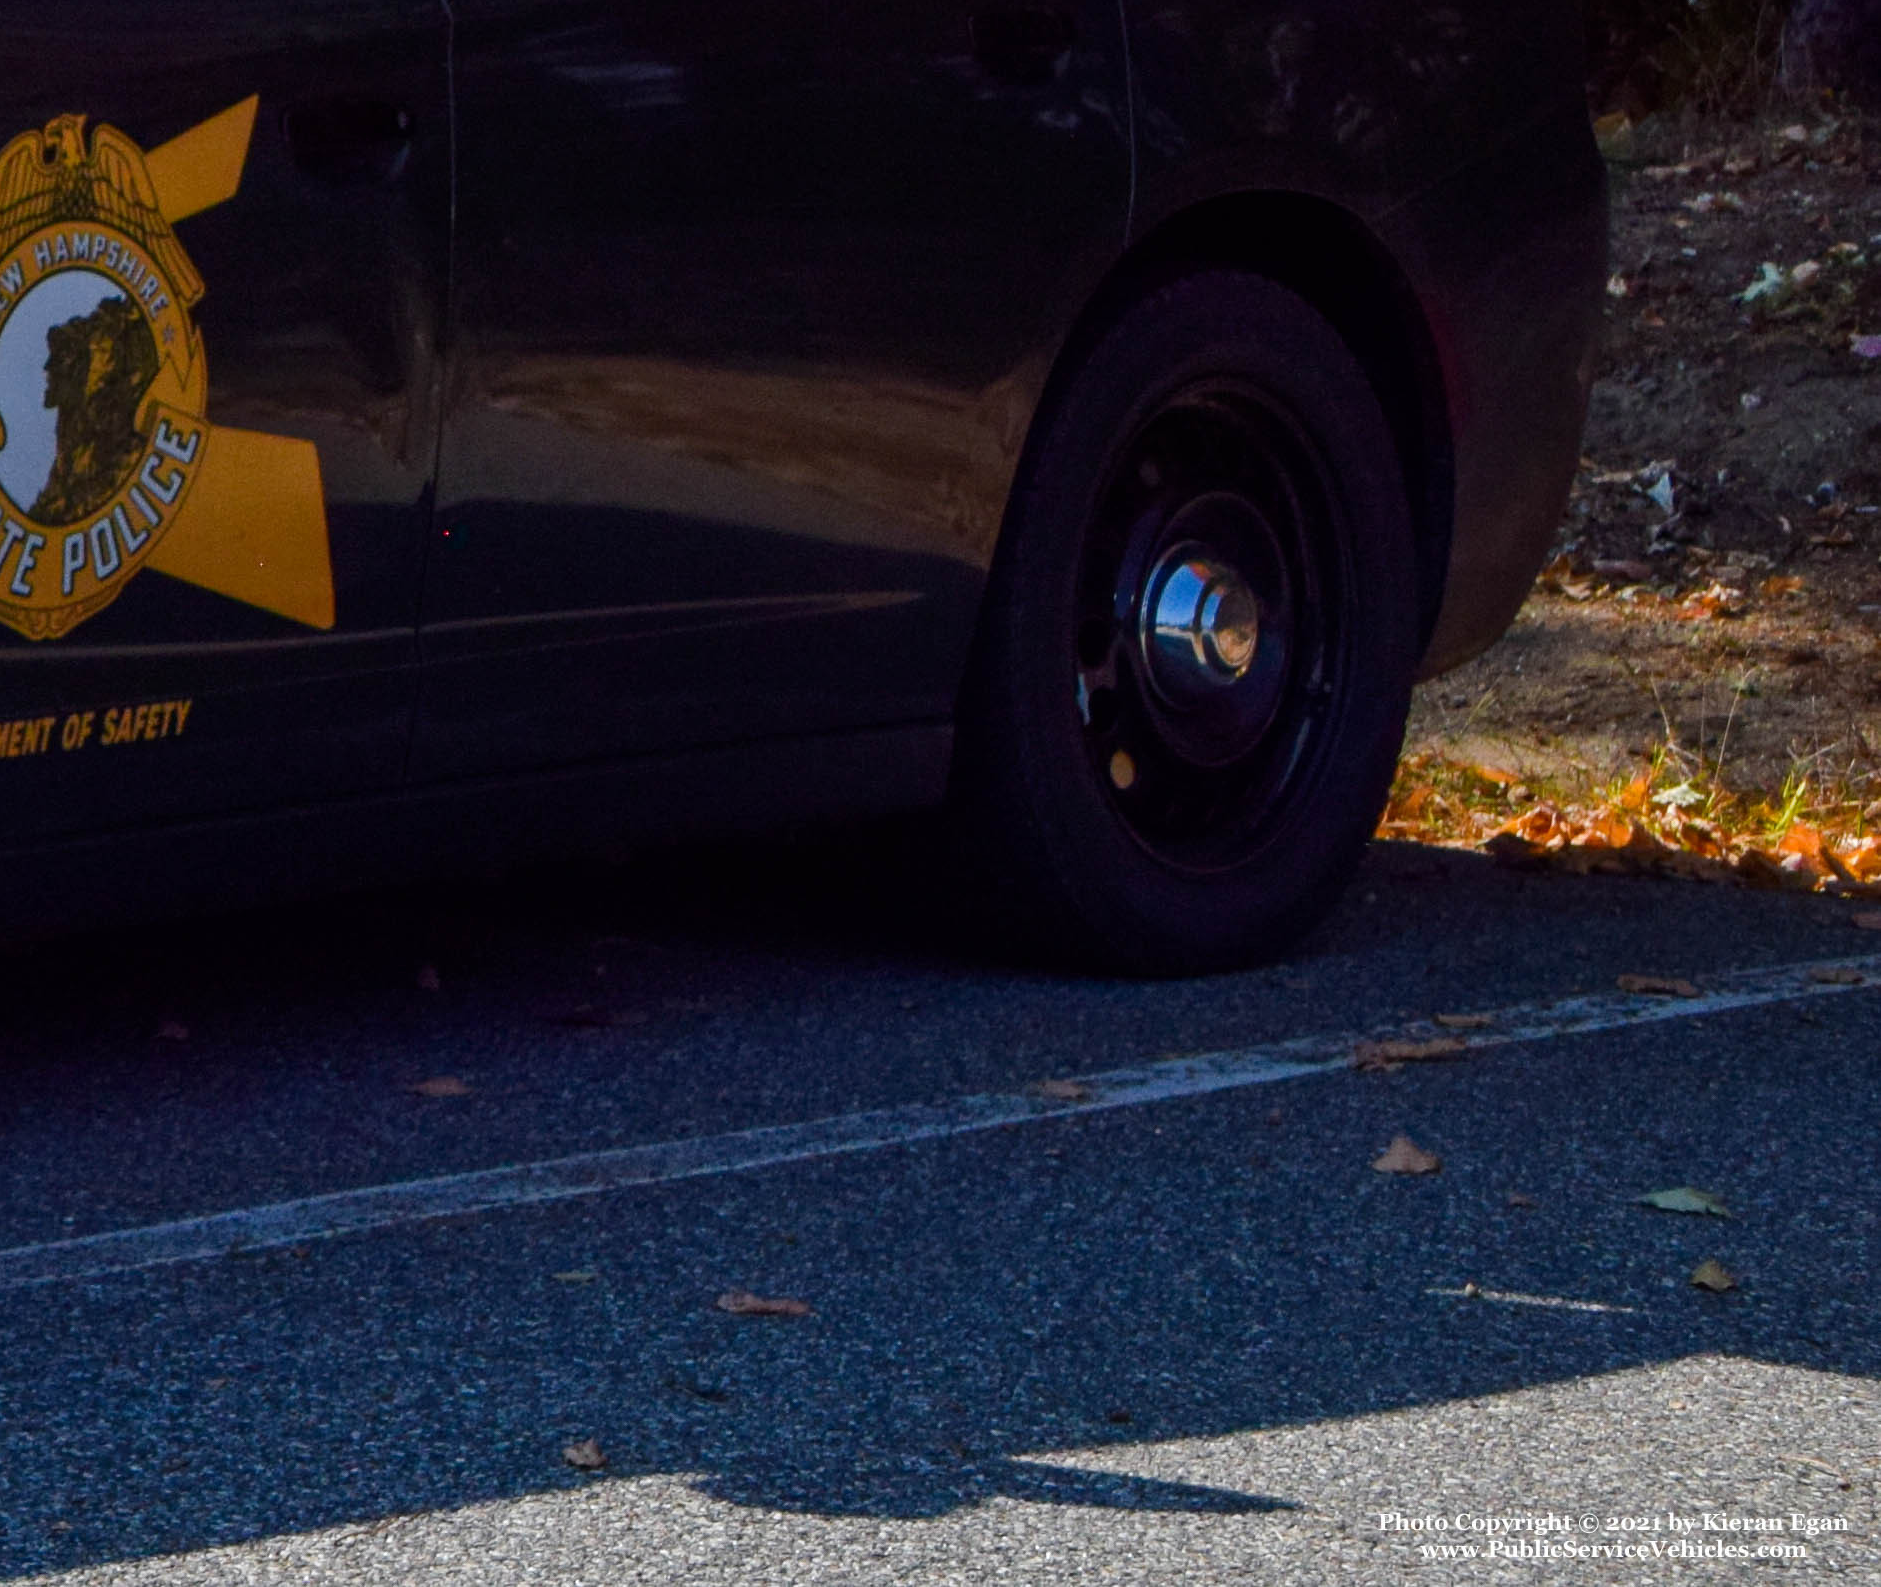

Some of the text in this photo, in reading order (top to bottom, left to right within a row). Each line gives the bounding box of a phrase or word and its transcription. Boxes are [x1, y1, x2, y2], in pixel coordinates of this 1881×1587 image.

[34, 232, 167, 317] HAMPSHIRE
[62, 417, 201, 595] POLICE
[61, 710, 96, 752] OF
[100, 699, 193, 747] SAFETY
